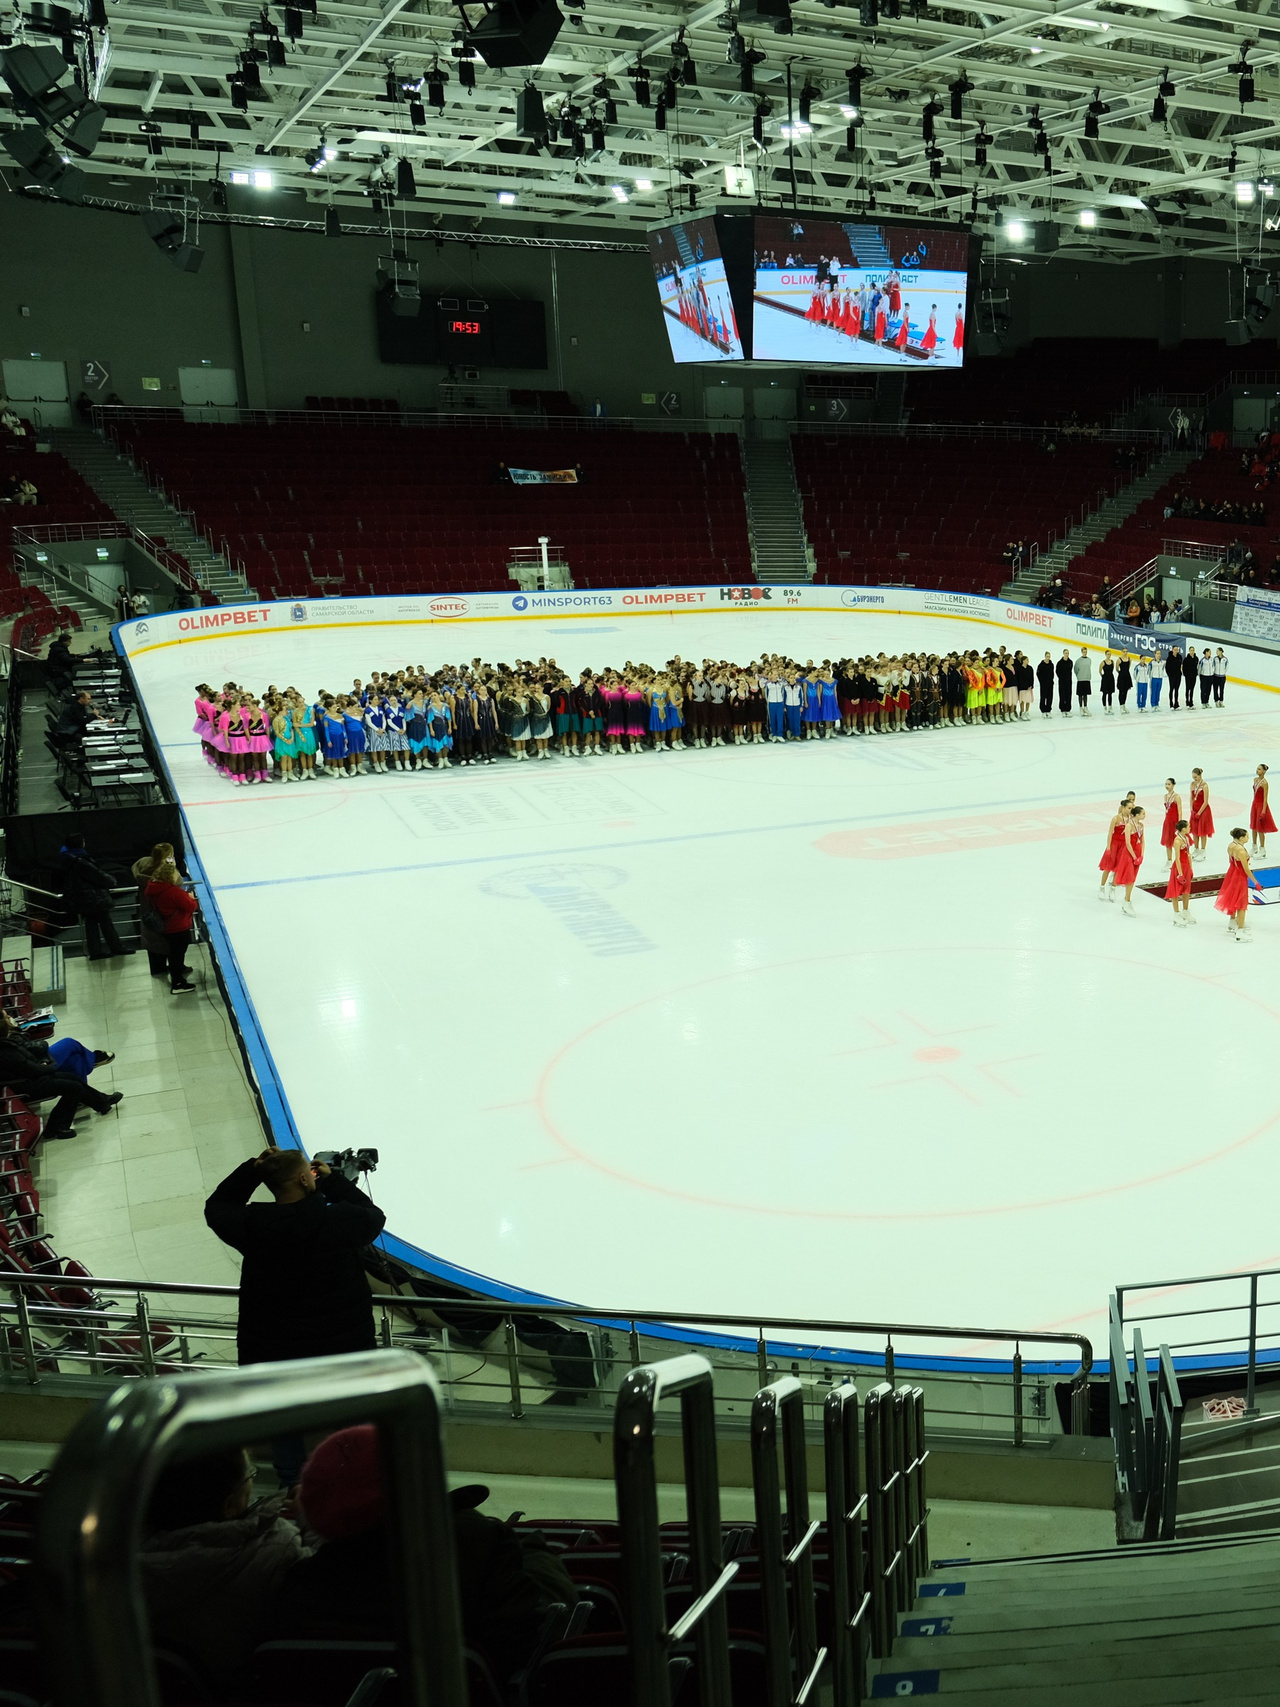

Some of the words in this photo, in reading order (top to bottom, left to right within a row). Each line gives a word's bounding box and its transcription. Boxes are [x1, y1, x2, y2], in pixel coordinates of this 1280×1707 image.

[781, 274, 847, 285] OLIMT
[452, 321, 480, 334] 19:53
[86, 362, 95, 376] 2
[670, 393, 677, 404] 2
[831, 400, 837, 411] 3
[622, 592, 706, 605] OLIMPBET
[783, 589, 802, 597] 89.6
[531, 595, 613, 608] MINSPORT63
[787, 597, 799, 605] FM
[924, 592, 968, 604] GENTLEMEN
[968, 595, 990, 608] LEAGUE
[429, 603, 467, 611] SINTEC
[178, 608, 271, 631] OLIMPBET
[1006, 607, 1054, 628] OLIMPBET
[1110, 632, 1133, 643] ЭНЕРГИЯ
[1135, 634, 1157, 652] ГЭС
